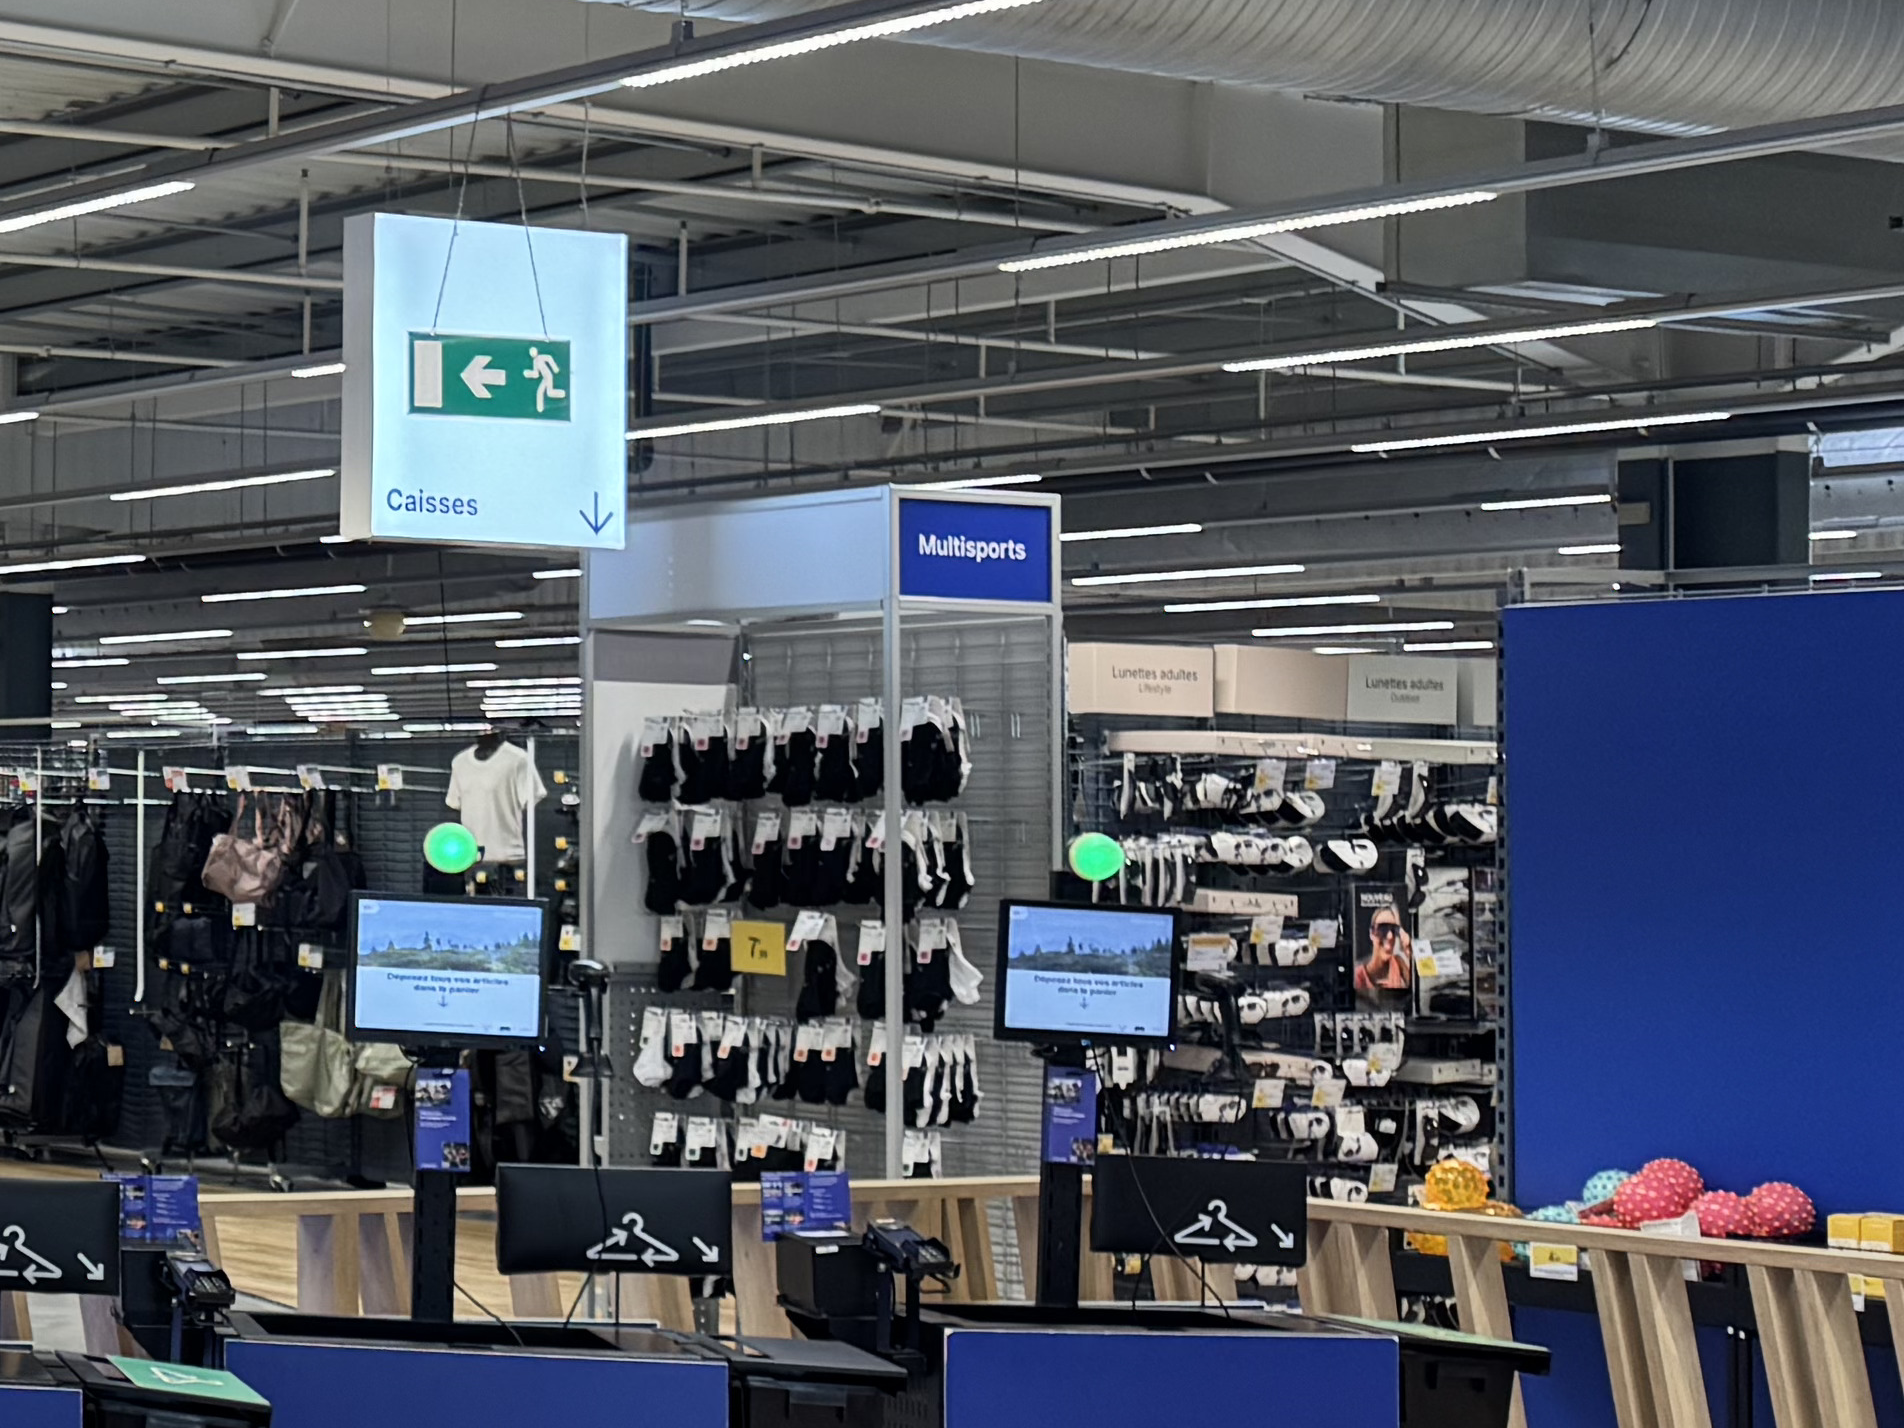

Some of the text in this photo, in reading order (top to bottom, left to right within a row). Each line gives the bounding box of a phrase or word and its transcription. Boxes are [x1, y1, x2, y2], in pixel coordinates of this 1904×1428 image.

[386, 488, 478, 516] Caisses
[918, 533, 1027, 563] Multisports
[1112, 665, 1198, 683] Lunettes adultes
[1366, 676, 1444, 692] Lunettes adultes
